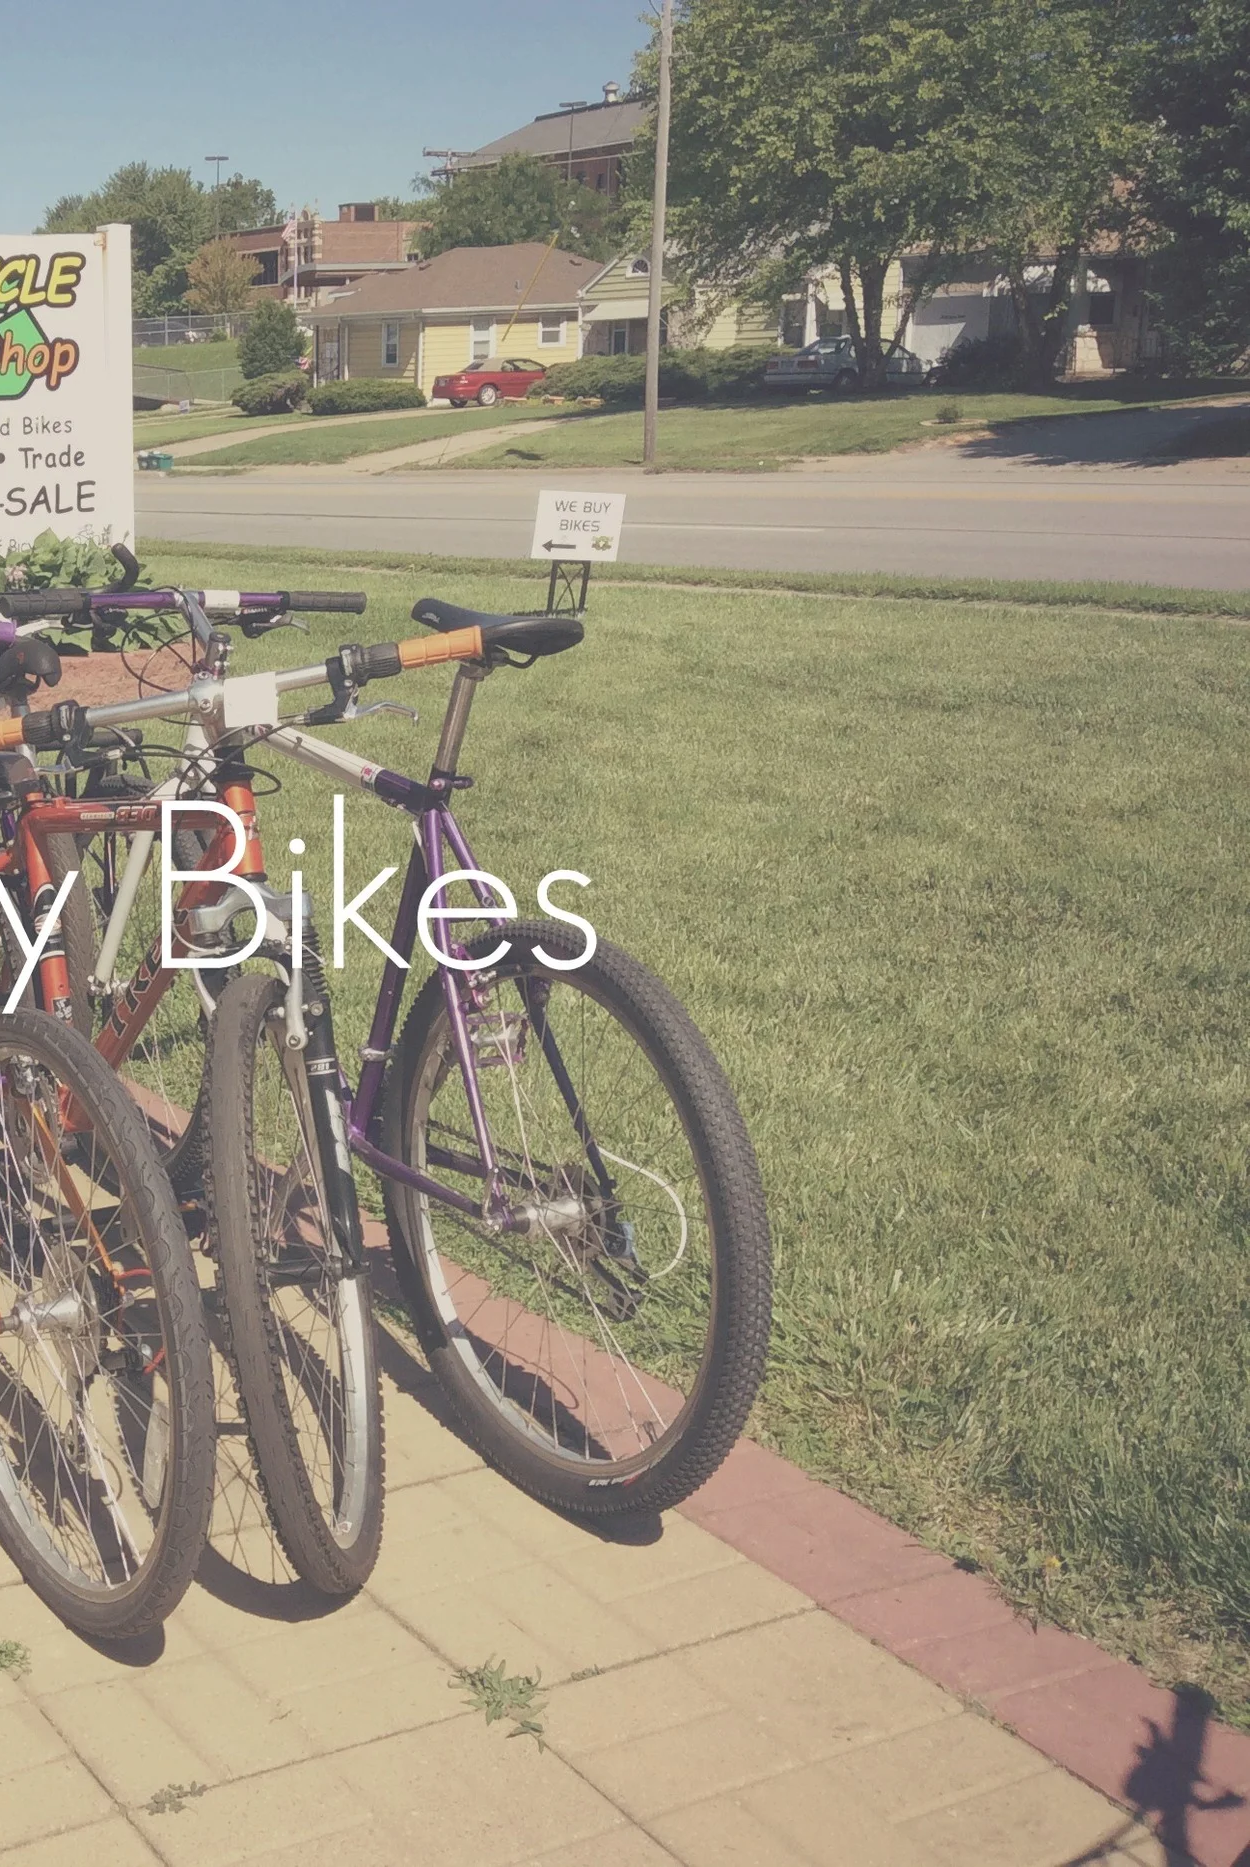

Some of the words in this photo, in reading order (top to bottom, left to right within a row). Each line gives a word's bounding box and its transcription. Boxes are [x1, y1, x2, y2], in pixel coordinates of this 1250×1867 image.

[23, 415, 72, 435] Bikes
[19, 444, 86, 470] Trade
[555, 500, 578, 512] WE
[583, 501, 611, 513] BUY
[559, 519, 600, 532] BIKES
